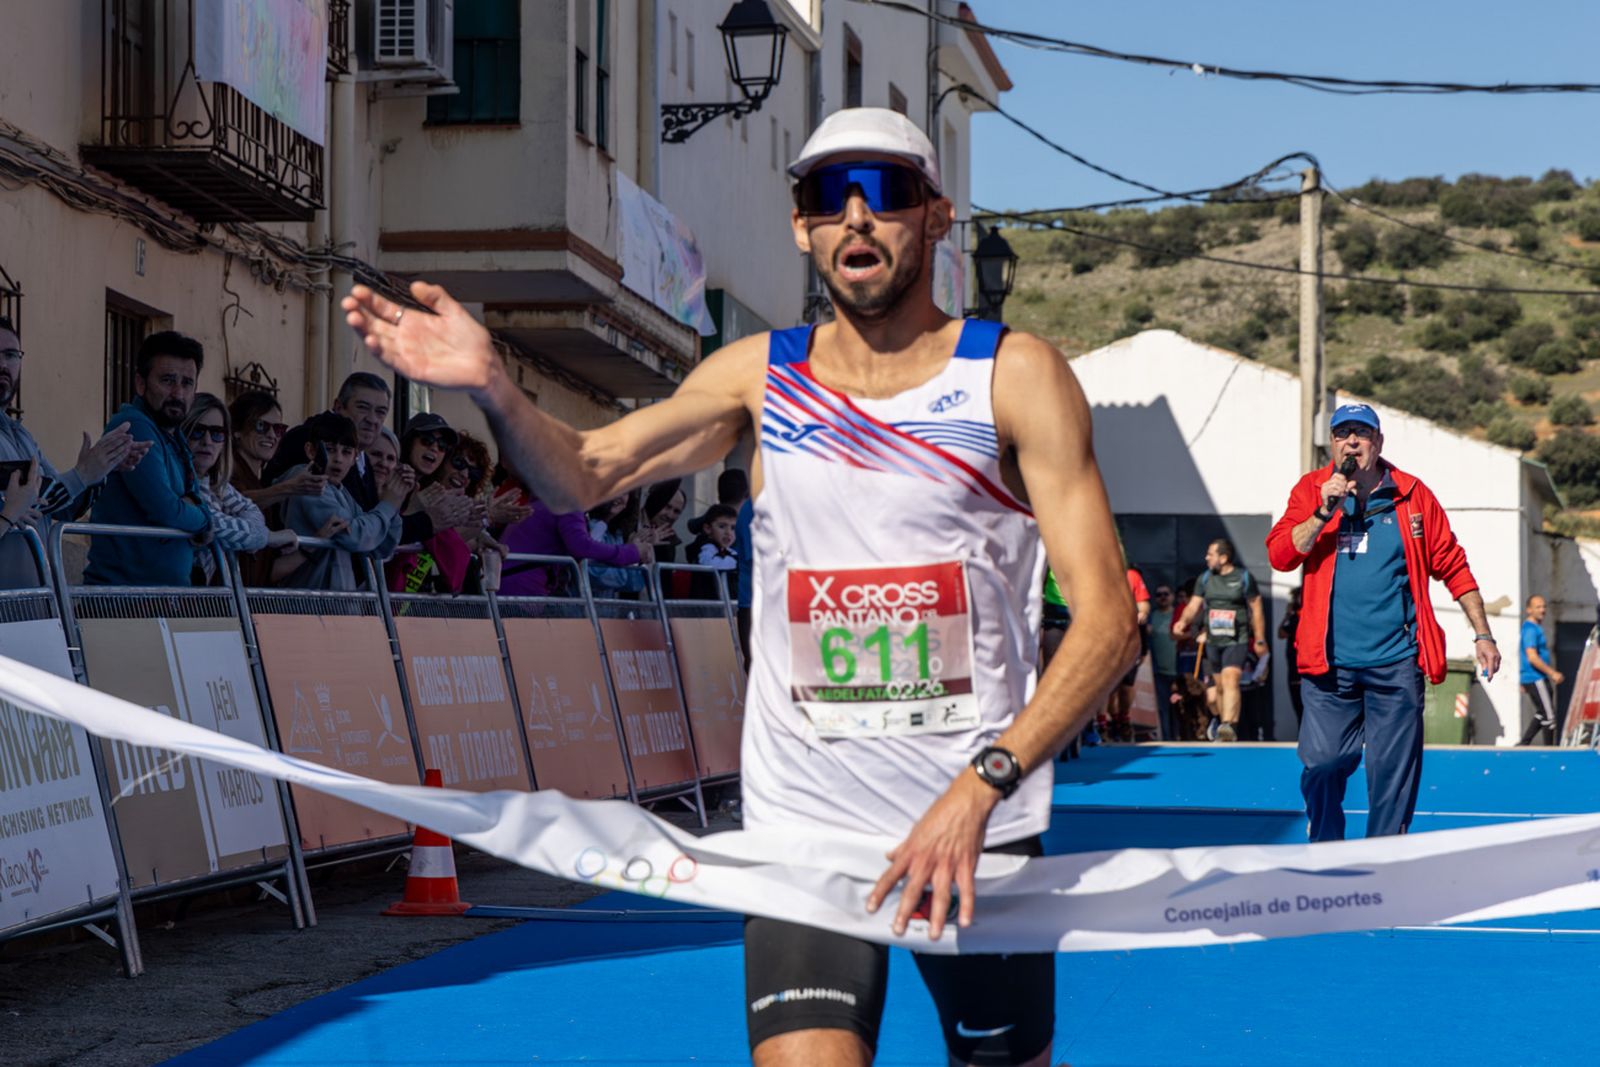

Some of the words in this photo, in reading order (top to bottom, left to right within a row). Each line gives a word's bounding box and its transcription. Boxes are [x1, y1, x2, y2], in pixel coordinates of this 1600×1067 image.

[808, 576, 837, 609] X
[841, 580, 940, 609] CROSS
[809, 607, 919, 630] PANTANO
[821, 623, 930, 684] 611
[412, 656, 453, 706] CROSS
[450, 656, 506, 704] PANTANO
[428, 734, 459, 785] DEL
[217, 768, 264, 809] MARTOS
[46, 796, 94, 827] NETWORK
[1164, 900, 1263, 923] Concejalía
[1267, 898, 1291, 915] de
[1295, 892, 1383, 912] Deportes
